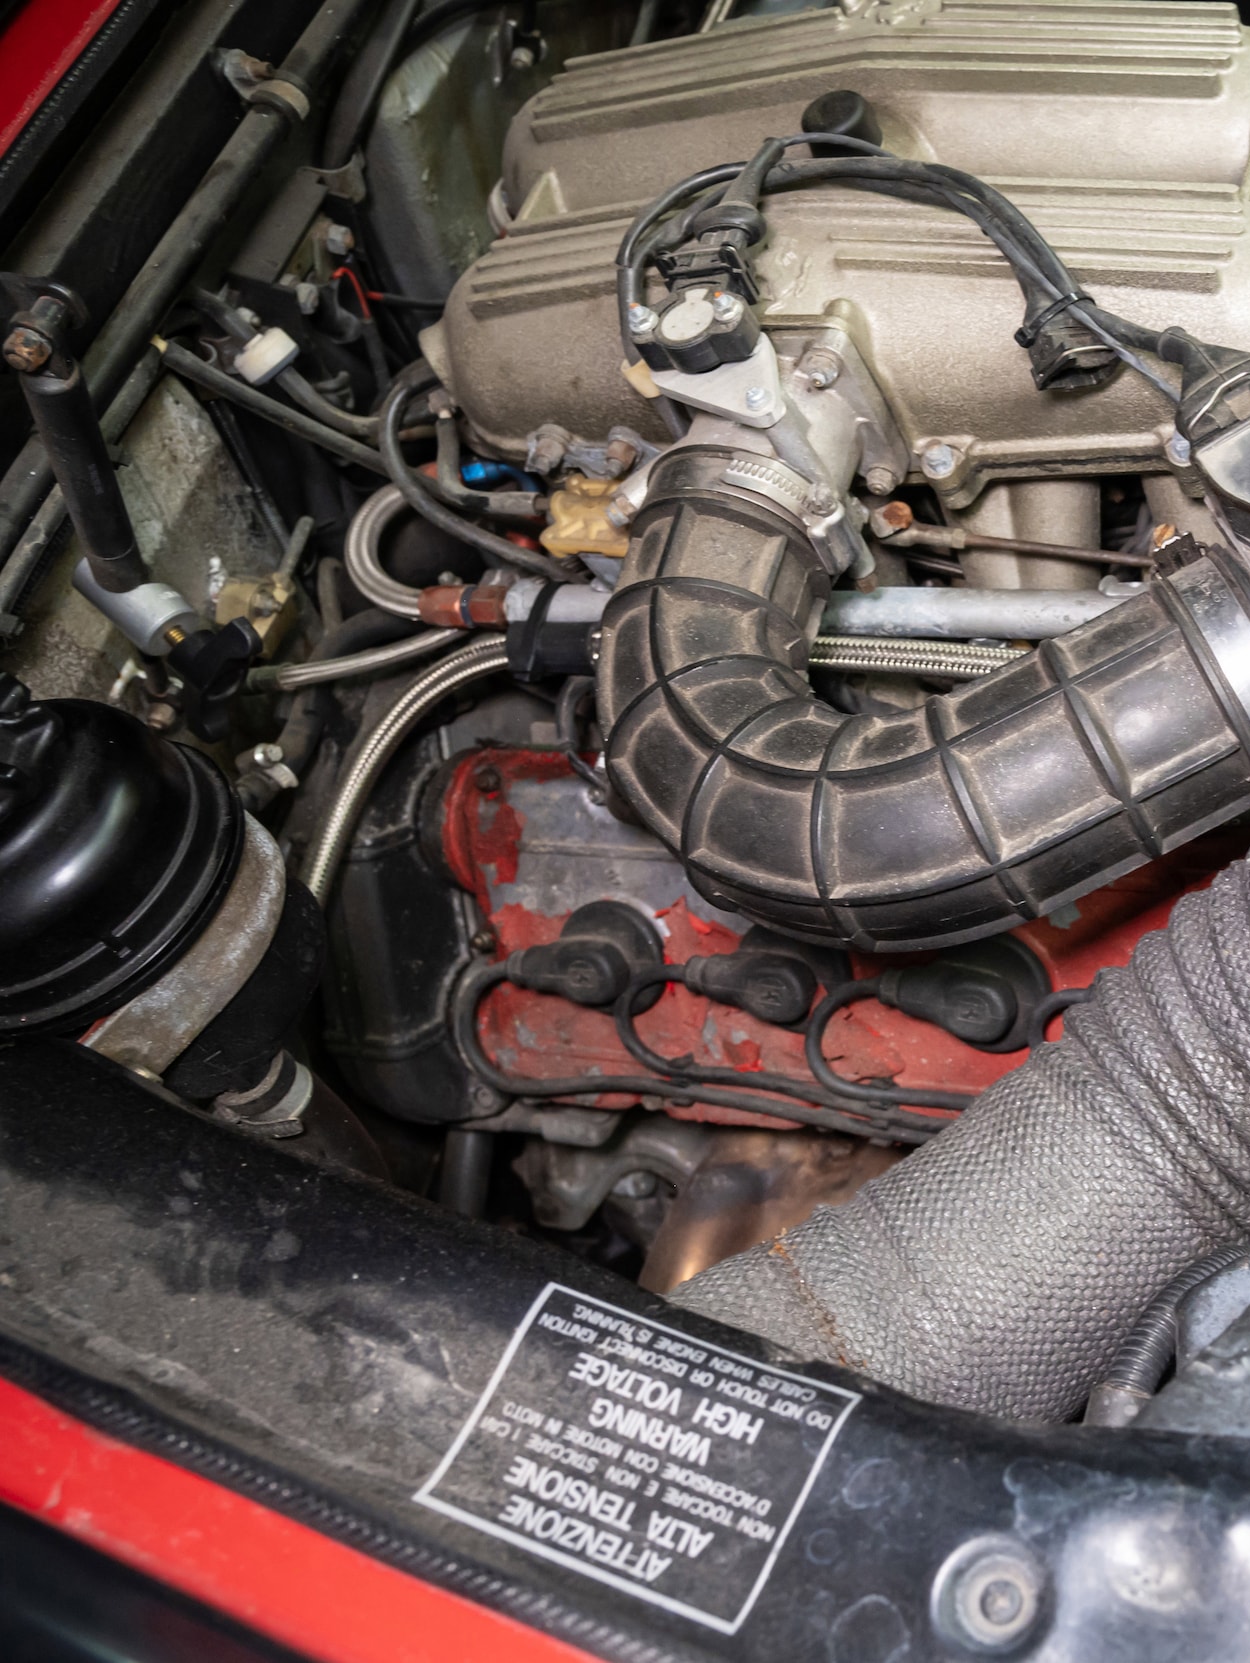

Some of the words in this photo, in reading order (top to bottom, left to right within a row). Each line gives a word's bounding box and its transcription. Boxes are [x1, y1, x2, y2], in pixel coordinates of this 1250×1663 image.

[538, 1313, 604, 1344] IGNITION
[636, 1329, 653, 1343] IS
[597, 1334, 688, 1377] DISCONNECT
[654, 1337, 707, 1363] ENGINE
[569, 1353, 681, 1415] VOLTAGE
[689, 1369, 714, 1387] OR
[709, 1357, 753, 1381] WHEN
[716, 1379, 772, 1408] TOUCH
[754, 1371, 817, 1407] CABLES
[692, 1398, 763, 1444] HIGH
[769, 1399, 806, 1419] NOT
[806, 1411, 832, 1430] DO
[512, 1428, 521, 1440] I
[545, 1418, 562, 1435] IN
[563, 1425, 622, 1458] MOTORE
[589, 1398, 711, 1465] WARNING
[525, 1433, 598, 1473] STACCARE
[624, 1449, 658, 1473] CON
[605, 1466, 640, 1489] NON
[644, 1480, 659, 1497] E
[662, 1463, 771, 1516] D'ACCENSIONE
[504, 1456, 635, 1531] TENSIONE
[663, 1487, 733, 1526] TOCCARE
[499, 1495, 672, 1581] ATTENZIONE
[647, 1511, 714, 1557] ALTA
[737, 1517, 774, 1541] NON
